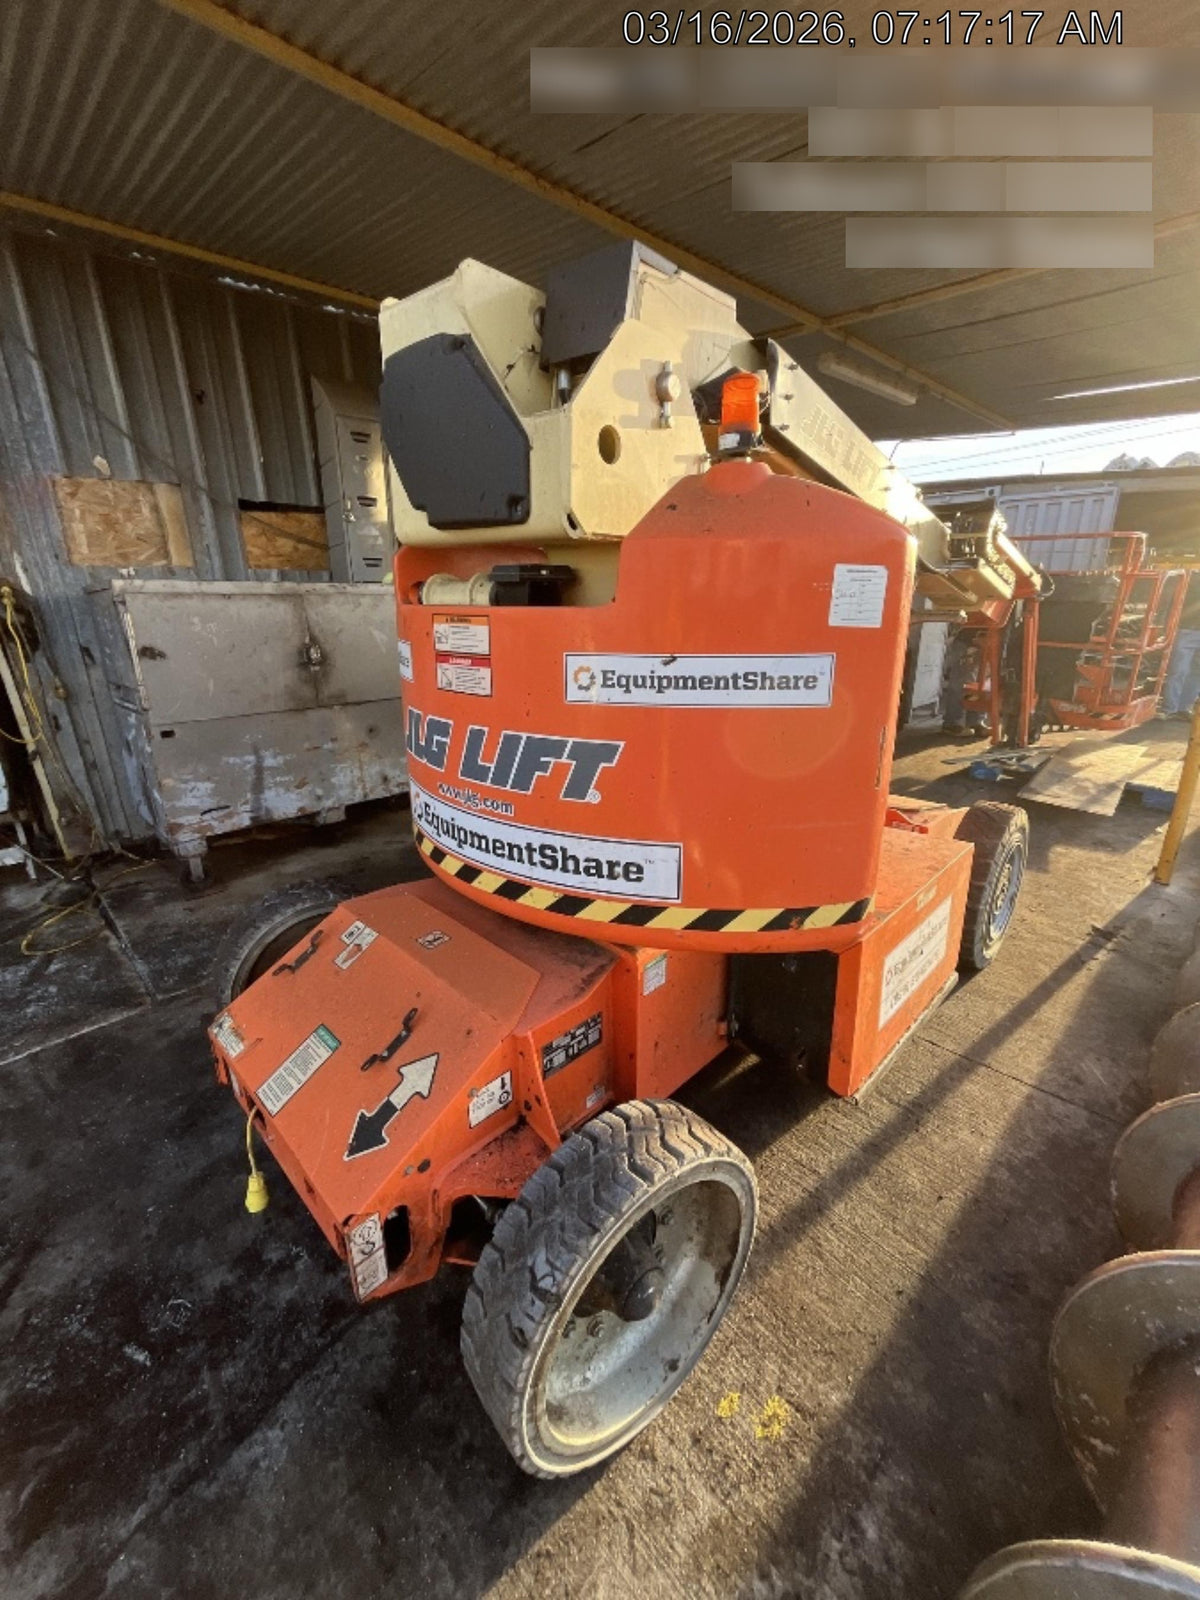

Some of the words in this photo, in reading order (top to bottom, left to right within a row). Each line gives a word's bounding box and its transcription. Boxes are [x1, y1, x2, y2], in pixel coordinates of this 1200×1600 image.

[600, 668, 819, 694] EquipmentShare
[406, 706, 453, 772] JLG
[458, 725, 626, 801] LIFT
[423, 801, 645, 883] EquipmentShare
